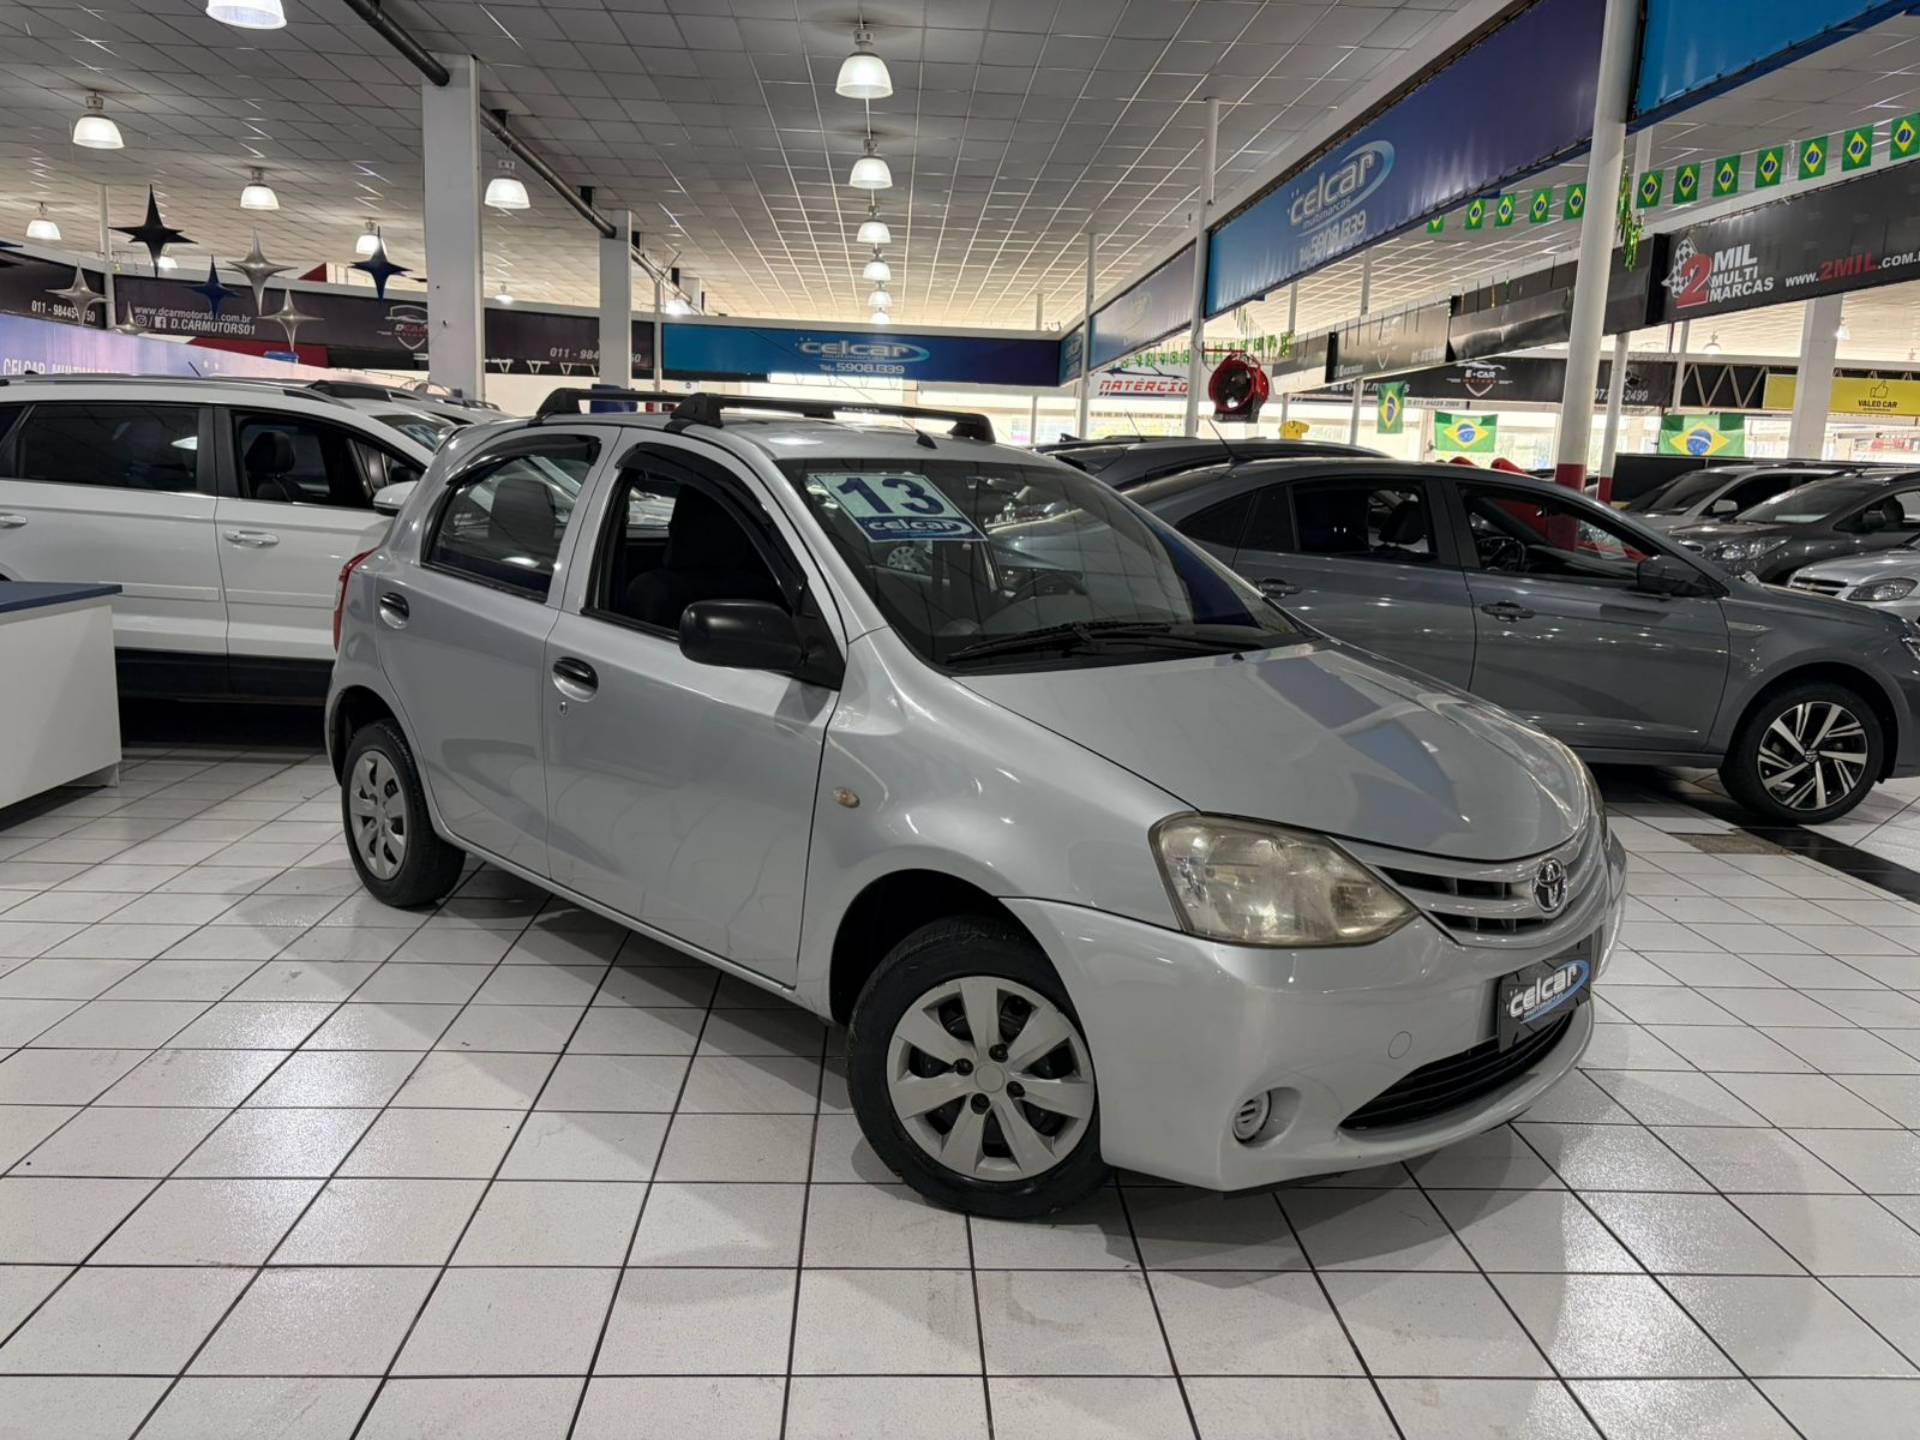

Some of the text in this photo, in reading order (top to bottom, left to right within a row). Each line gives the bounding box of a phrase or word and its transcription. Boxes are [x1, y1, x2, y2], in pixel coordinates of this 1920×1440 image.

[1290, 152, 1375, 225] celcar
[1713, 244, 1757, 272] MIL
[1709, 276, 1774, 303] MARCAS
[1711, 265, 1758, 289] MULTI
[31, 300, 46, 312] 011
[550, 347, 570, 357] 011
[801, 340, 909, 357] celcar
[837, 477, 945, 515] 13
[868, 519, 956, 531] celcar
[1510, 963, 1577, 1018] celcar
